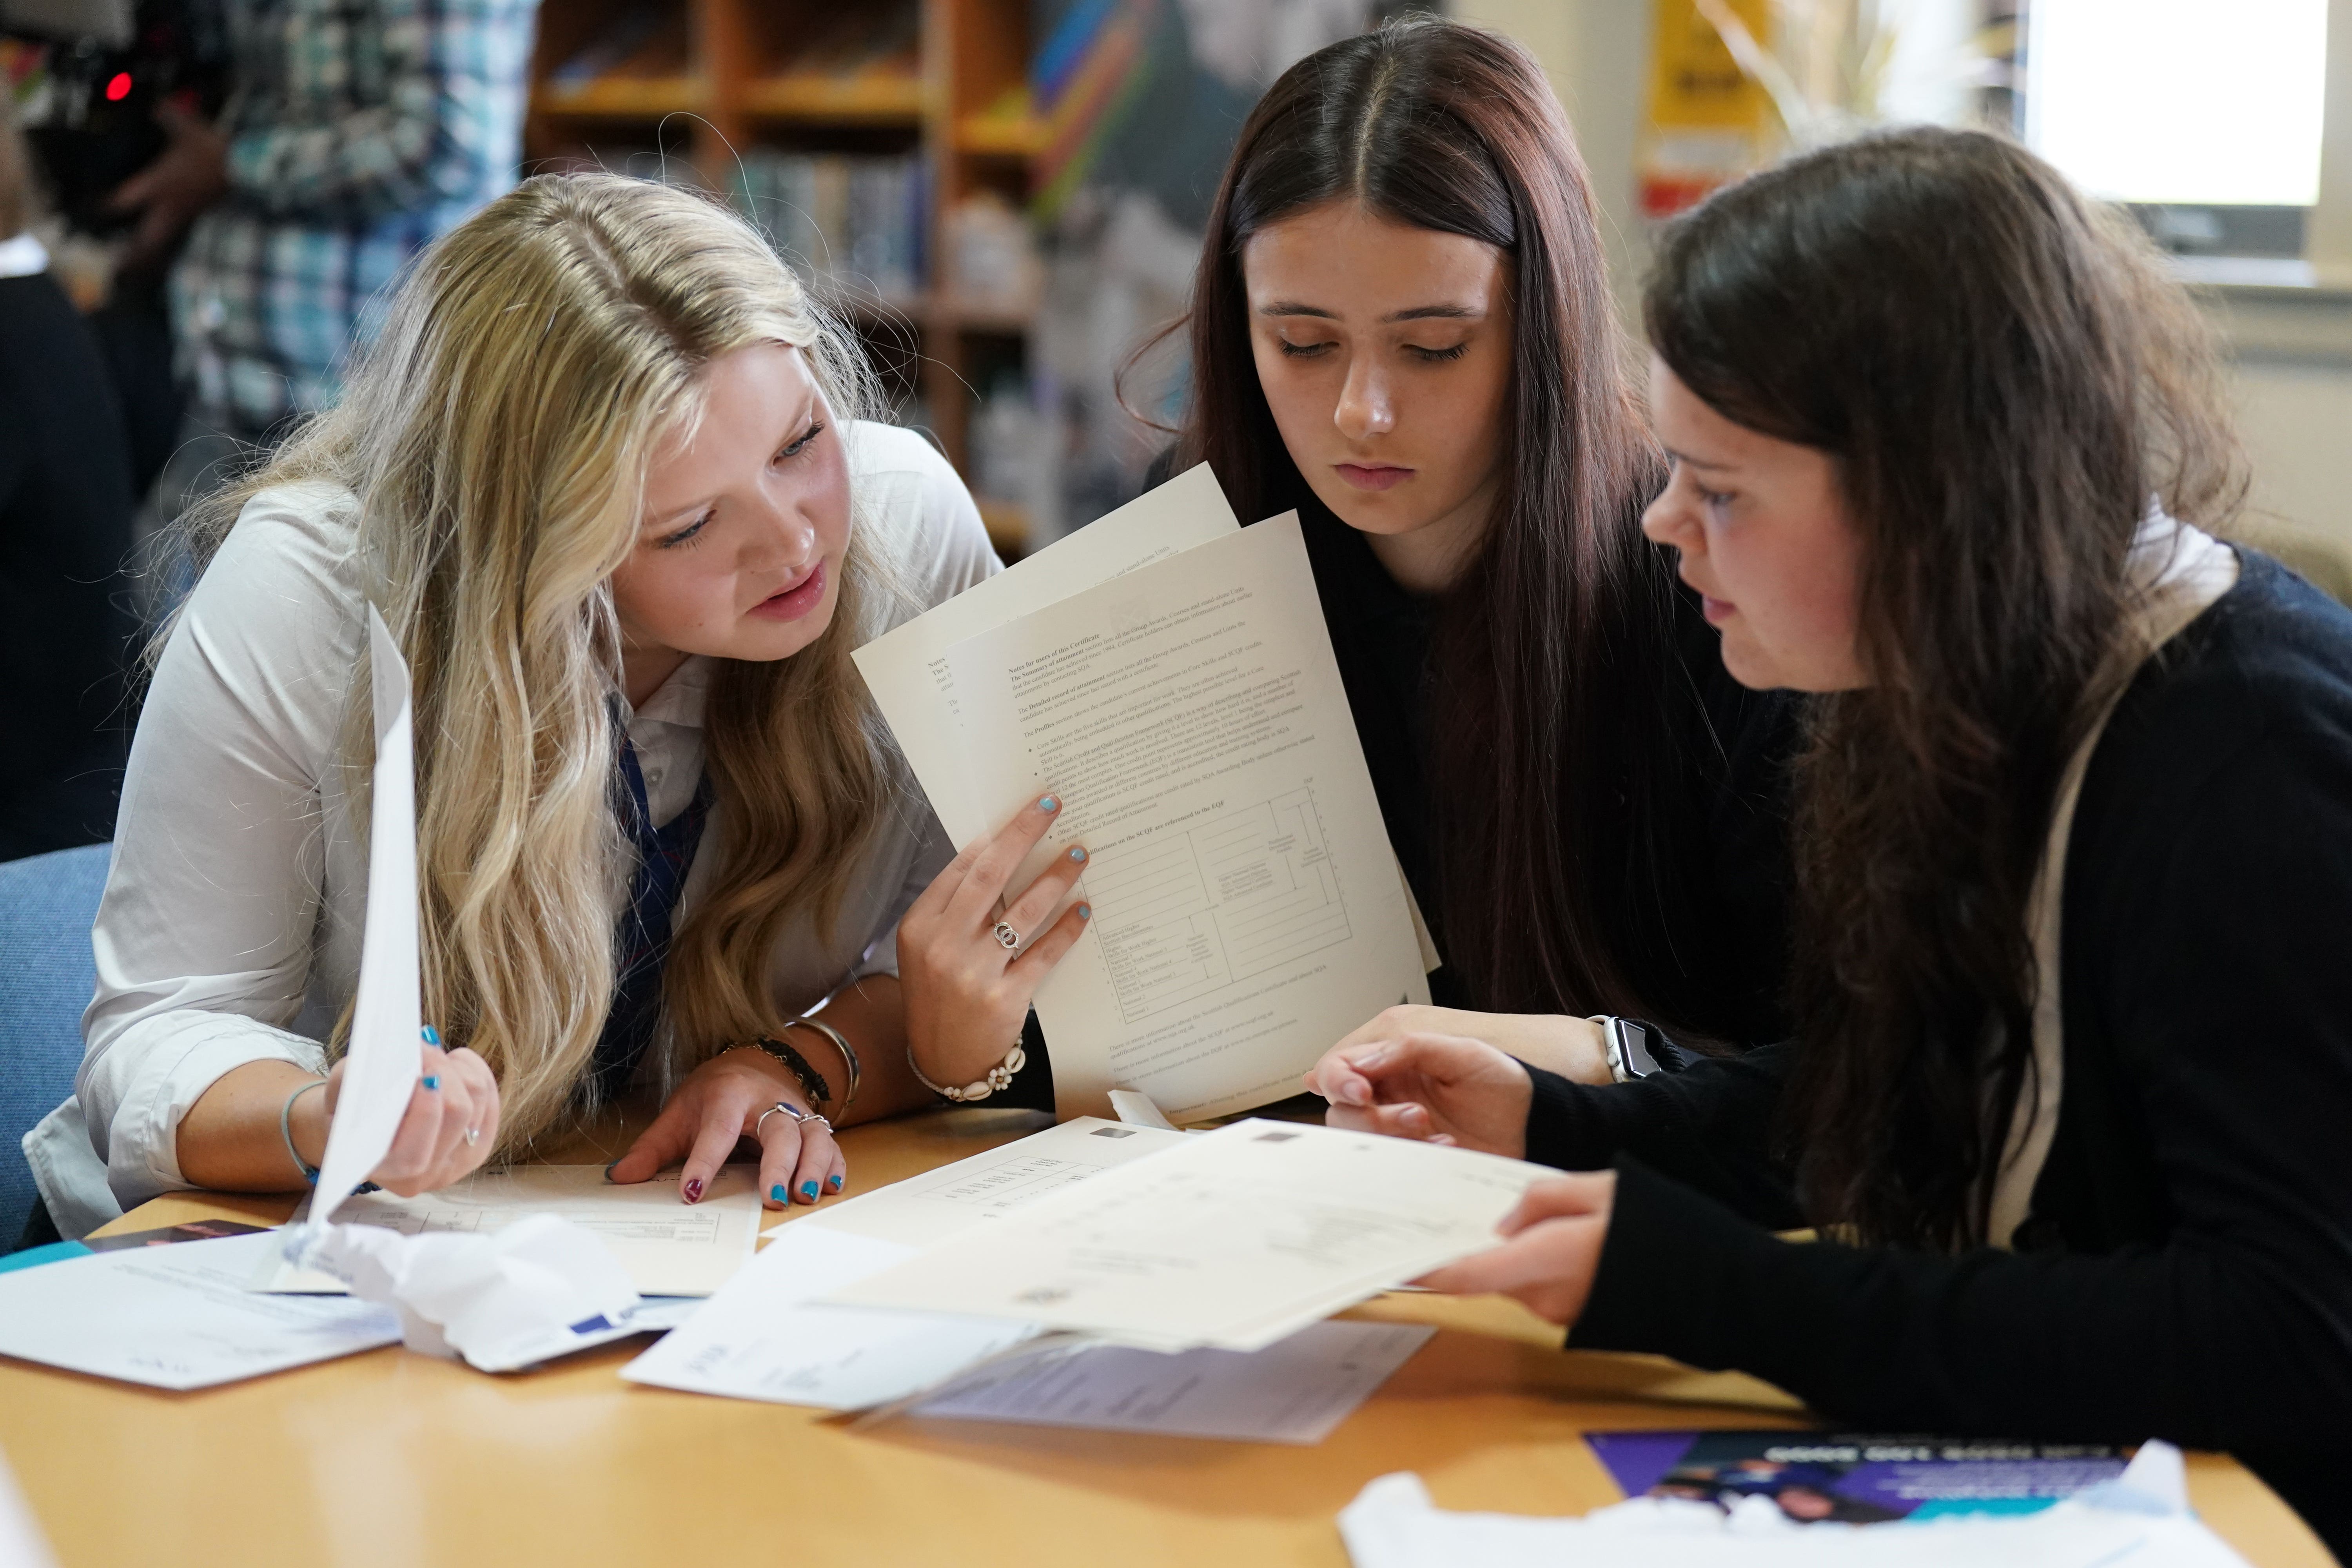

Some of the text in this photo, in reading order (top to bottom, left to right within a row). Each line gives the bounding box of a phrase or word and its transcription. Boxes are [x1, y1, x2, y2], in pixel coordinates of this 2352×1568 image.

[1126, 554, 1154, 572] stand-alone
[1155, 546, 1170, 556] Units
[1008, 664, 1025, 674] Notes
[1036, 654, 1050, 663] users
[1070, 634, 1100, 649] Certificate
[1022, 664, 1047, 677] Summary
[1055, 648, 1084, 664] attainment
[1085, 642, 1102, 652] section
[1131, 624, 1148, 633] Group
[1169, 608, 1189, 618] Courses
[1201, 592, 1230, 606] stand-alone
[1230, 586, 1244, 595] Units
[1031, 670, 1055, 682] candidate
[1065, 655, 1088, 668] achieved
[1089, 650, 1102, 659] since
[1117, 634, 1143, 647] Certificate
[1144, 626, 1163, 636] holders
[1174, 616, 1190, 625] obtain
[1191, 604, 1220, 618] information
[1221, 598, 1236, 607] about
[927, 657, 946, 669] Notes
[931, 667, 943, 676] The
[1014, 684, 1043, 698] attainments
[1051, 670, 1077, 683] contacting
[1028, 696, 1051, 710] Detailed
[1052, 689, 1069, 700] record
[1076, 674, 1105, 690] attainment
[1106, 668, 1124, 677] section
[1152, 650, 1169, 659] Group
[1191, 634, 1211, 645] Courses
[1212, 628, 1222, 637] and
[1020, 710, 1044, 722] candidate
[1054, 695, 1076, 708] achieved
[1076, 690, 1089, 699] since
[1100, 678, 1116, 689] issued
[1117, 673, 1128, 682] with
[1034, 722, 1054, 733] Profiles
[1055, 715, 1073, 724] section
[1074, 708, 1090, 717] shows
[1128, 684, 1146, 695] current
[1201, 658, 1216, 666] Skills
[1050, 735, 1064, 744] Skills
[1094, 717, 1107, 726] skills
[1127, 699, 1152, 713] important
[1200, 676, 1214, 684] often
[1215, 666, 1238, 679] achieved
[1074, 734, 1089, 742] being
[1089, 722, 1114, 737] embedded
[1122, 715, 1135, 723] other
[1183, 689, 1201, 699] highest
[1203, 681, 1224, 693] possible
[1041, 756, 1053, 765] Skill
[1053, 756, 1073, 768] Scottish
[1073, 750, 1090, 760] Credit
[1100, 733, 1134, 750] Qualification
[1134, 720, 1164, 736] Framework
[1136, 826, 1153, 837] SCQF
[1165, 811, 1194, 826] referenced
[1211, 800, 1224, 809] EQF
